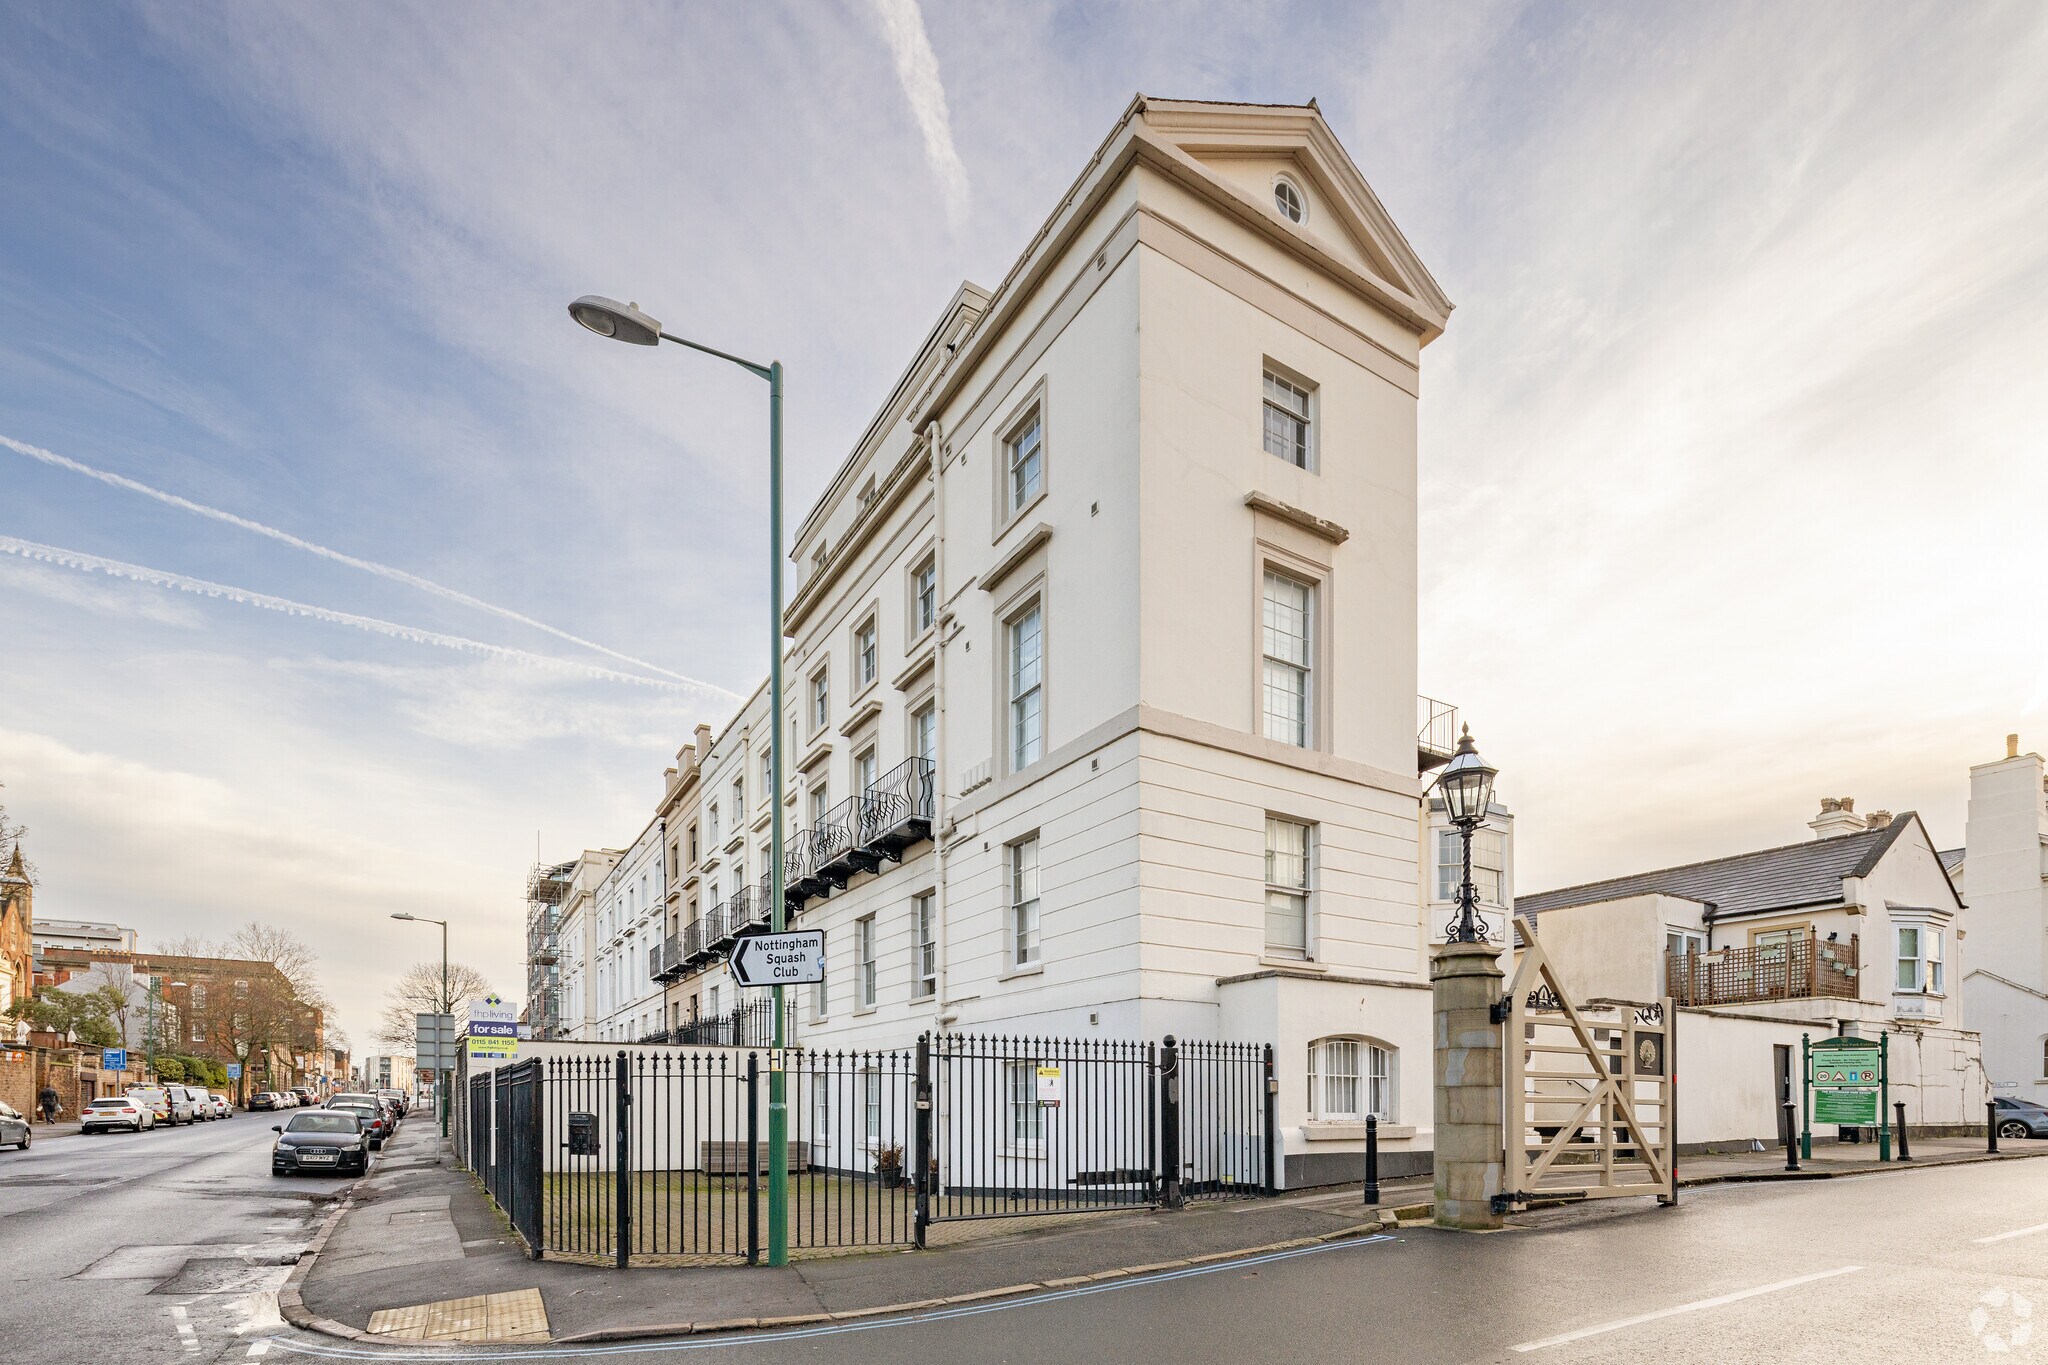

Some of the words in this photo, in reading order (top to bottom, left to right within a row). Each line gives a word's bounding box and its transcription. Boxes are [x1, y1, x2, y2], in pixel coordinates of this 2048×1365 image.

[755, 938, 818, 951] Nottingham
[766, 951, 806, 965] Squash
[773, 966, 799, 977] Club
[473, 1024, 490, 1033] for
[490, 1025, 513, 1035] sale
